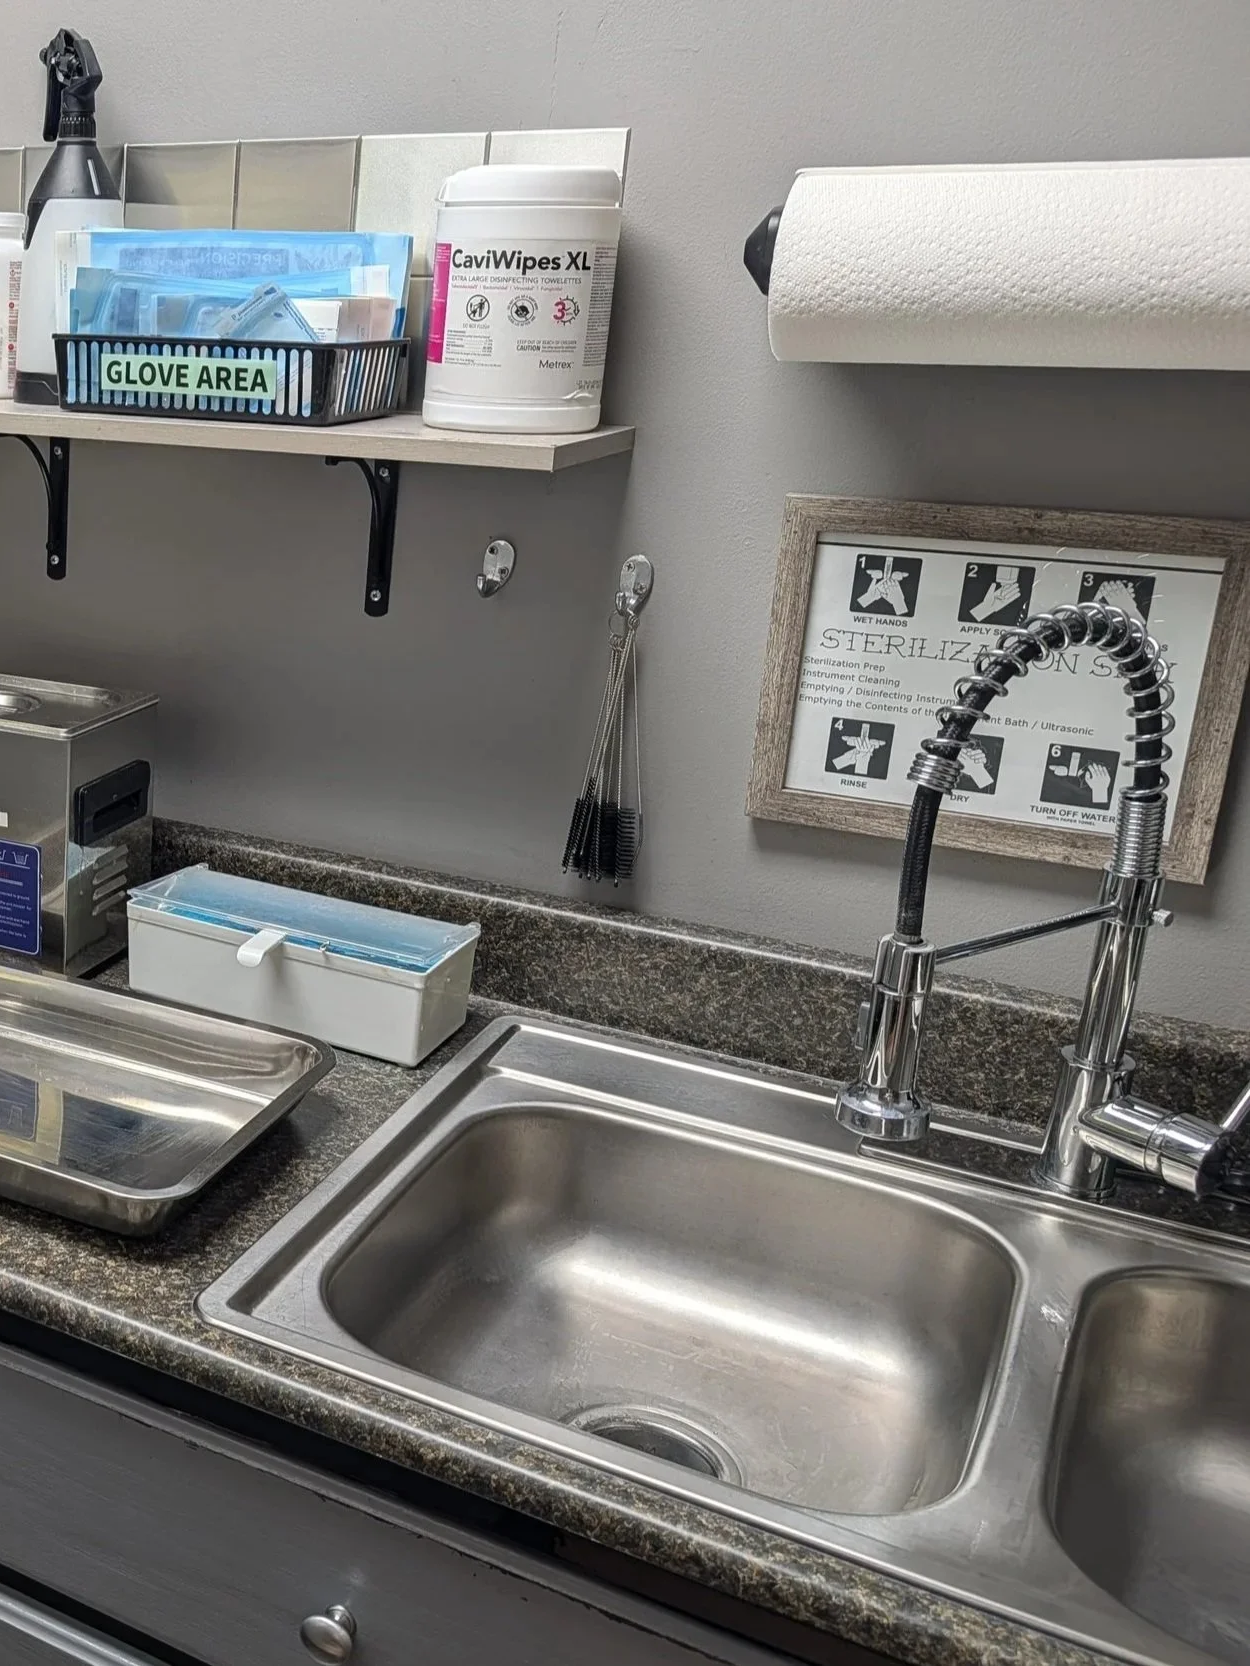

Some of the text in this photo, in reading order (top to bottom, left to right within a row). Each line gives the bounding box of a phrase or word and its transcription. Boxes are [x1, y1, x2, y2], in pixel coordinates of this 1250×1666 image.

[452, 249, 591, 275] CaviWipes XL
[490, 276, 538, 284] DISINFECTING
[553, 301, 566, 321] 3
[539, 360, 572, 369] Metrex
[107, 360, 269, 393] GLOVE AREA
[859, 556, 866, 568] 1
[967, 564, 979, 578] 2
[1083, 574, 1094, 587] 3
[853, 615, 908, 628] WET HANDS
[960, 625, 991, 636] APPLY
[803, 655, 886, 673] Sterilization Prep
[802, 668, 900, 687] Instrument Cleaning
[800, 681, 845, 695] Emptying
[855, 687, 913, 702] Disinfecting
[799, 693, 843, 707] Emptying
[846, 700, 862, 708] the
[864, 701, 908, 714] Contents
[911, 706, 922, 715] of
[834, 719, 844, 731] 4
[1004, 717, 1029, 728] Bath
[1040, 722, 1094, 736] Ultrasonic
[1051, 745, 1062, 757] 6
[840, 778, 867, 789] RINSE
[950, 794, 970, 803] DRY
[1030, 805, 1116, 823] TURN OFF WATER
